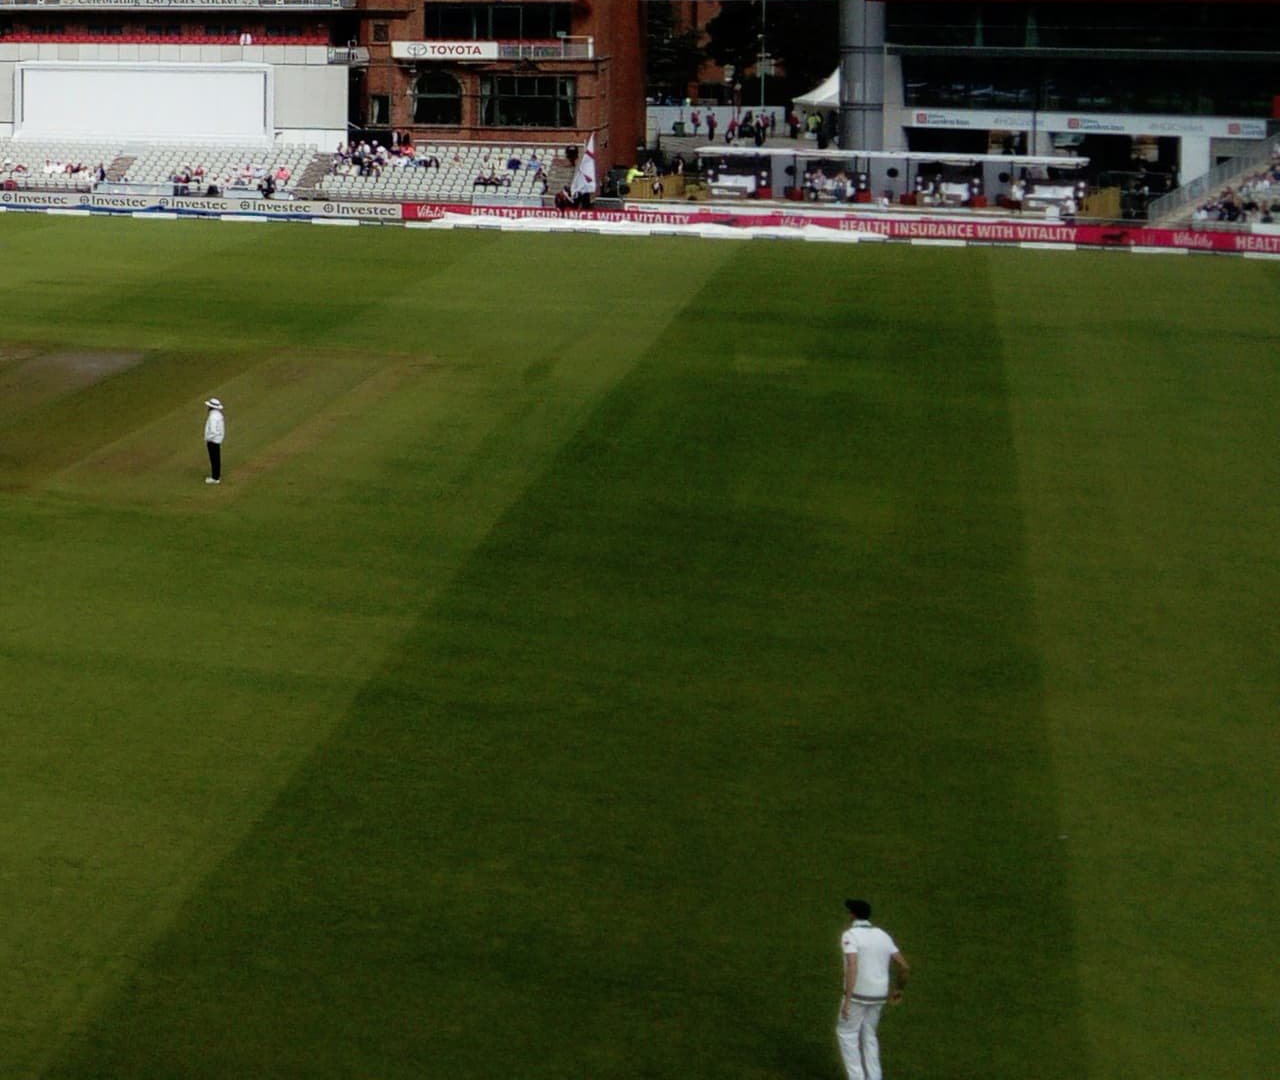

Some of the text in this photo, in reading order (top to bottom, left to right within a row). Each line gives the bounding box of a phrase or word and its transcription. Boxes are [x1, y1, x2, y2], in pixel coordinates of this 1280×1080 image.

[429, 45, 482, 55] TOYOTA
[14, 193, 68, 205] Investec
[91, 196, 147, 208] Investec
[171, 198, 228, 210] Investec
[252, 201, 311, 213] Investec
[336, 203, 397, 217] Investec
[840, 220, 1077, 241] HEALTH INSURANCE WITH VITALITY
[1235, 236, 1280, 252] HEALT
